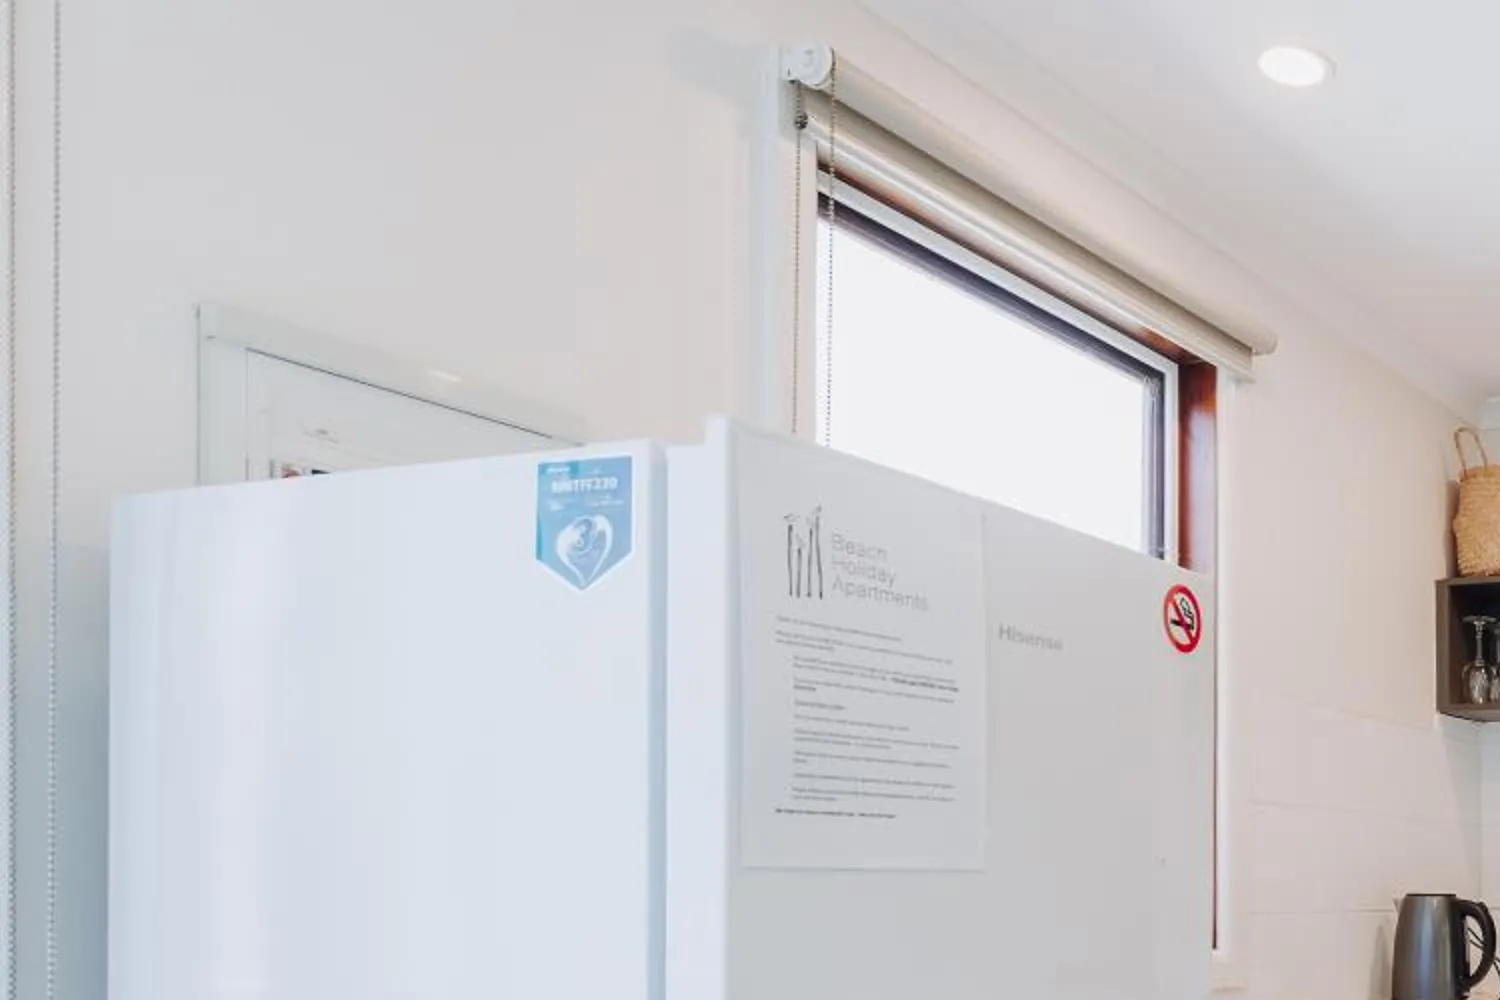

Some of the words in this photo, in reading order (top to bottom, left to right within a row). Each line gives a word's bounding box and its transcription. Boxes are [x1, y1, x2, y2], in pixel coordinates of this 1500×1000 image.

[831, 532, 888, 562] Beach
[831, 554, 897, 588] Holiday
[831, 574, 929, 611] Apartments
